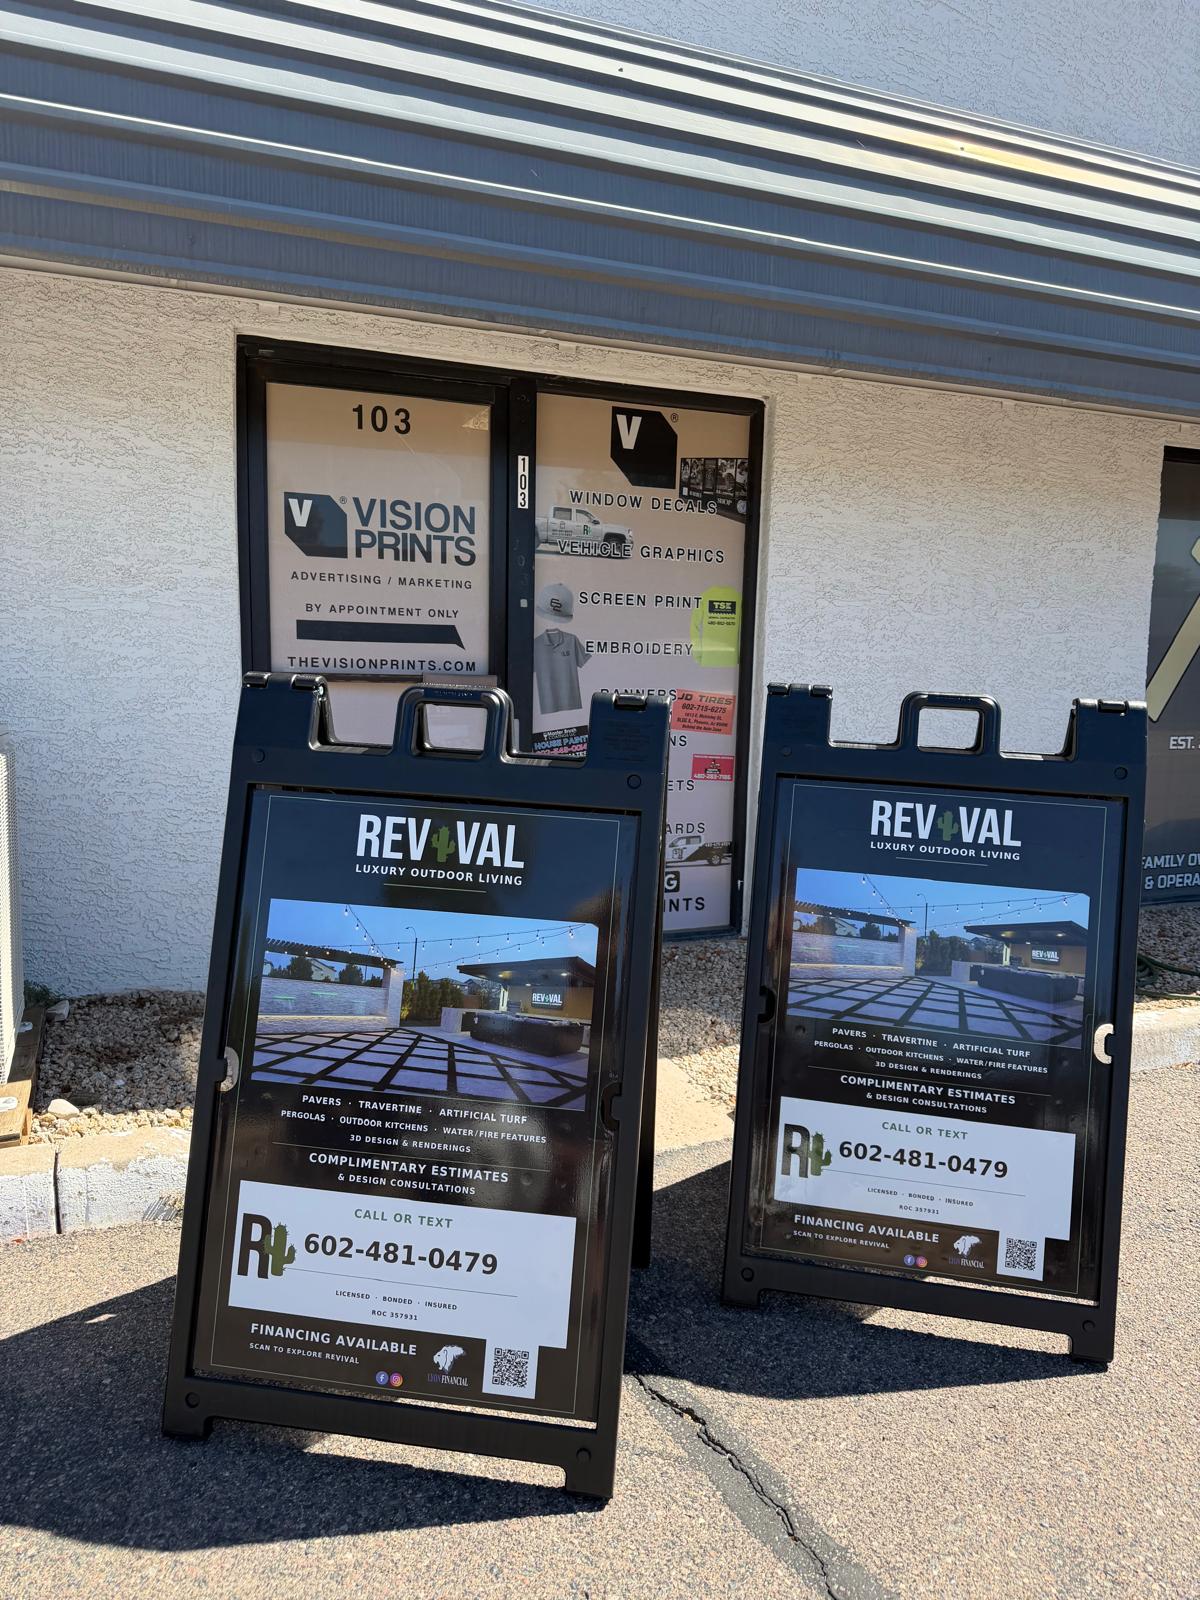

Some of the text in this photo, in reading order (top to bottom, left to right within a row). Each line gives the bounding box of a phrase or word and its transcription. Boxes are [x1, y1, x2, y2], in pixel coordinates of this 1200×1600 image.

[353, 404, 411, 434] 103
[570, 490, 717, 514] WINDOW DECALS
[353, 497, 476, 534] VISION
[355, 530, 476, 566] PRINTS
[557, 541, 724, 562] VEHICLE GRAPHICS
[291, 571, 381, 584] ADVERTISING
[398, 578, 472, 589] MARKETING
[579, 592, 702, 608] SCREEN PRINT
[305, 604, 459, 618] BY APPOINTMENT ONLY
[586, 641, 692, 655] EMBROIDERY
[288, 656, 476, 671] THEVISIONPRINTS.COM
[699, 696, 733, 705] TIRES
[1170, 736, 1195, 749] EST.
[871, 841, 1020, 860] LUXURY OUTDOOR LIVING
[356, 864, 522, 886] LUXURY OUTDOOR LIVING
[832, 1028, 1031, 1058] PAVERS TRAVERTINE ARTIFICIAL TURF
[814, 1040, 853, 1050] PERGOLAS
[866, 1046, 903, 1056] OUTDOOR
[906, 1050, 944, 1062] KITCHENS
[1007, 1064, 1048, 1074] FEATURES
[889, 1063, 918, 1072] DESIGN
[930, 1068, 982, 1079] RENDERINGS
[841, 1075, 1015, 1104] COMPLIMENTARY ESTIMATES
[302, 1095, 528, 1124] PAVERS TRAVERTINE ARTIFICIAL TURF
[876, 1094, 909, 1103] DESIGN
[912, 1098, 987, 1113] CONSULTATIONS
[281, 1110, 326, 1122] PERGOLAS
[340, 1116, 382, 1128] OUTDOOR
[385, 1120, 428, 1132] KITCHENS
[501, 1132, 546, 1144] FEATURES
[882, 1122, 968, 1140] CALL OR TEXT
[365, 1136, 399, 1146] DESIGN
[412, 1140, 471, 1153] RENDERINGS
[309, 1153, 508, 1183] COMPLIMENTARY ESTIMATES
[840, 1141, 1008, 1179] 602-481-0479
[338, 1173, 475, 1195] & DESIGN CONSULTATIONS
[945, 1198, 973, 1206] INSURED
[354, 1209, 453, 1228] CALL OR TEXT
[794, 1214, 939, 1243] FINANCING AVAILABLE
[826, 1235, 857, 1244] EXPLORE
[860, 1240, 889, 1248] REVIVAL
[304, 1233, 498, 1275] 602-481-0479
[336, 1290, 457, 1310] LICENSED BONDED INSURED
[390, 1312, 418, 1321] 357931
[251, 1323, 417, 1356] FINANCING AVAILABLE
[250, 1343, 270, 1351] SCAN
[286, 1347, 323, 1358] EXPLORE
[326, 1352, 359, 1364] REVIVAL
